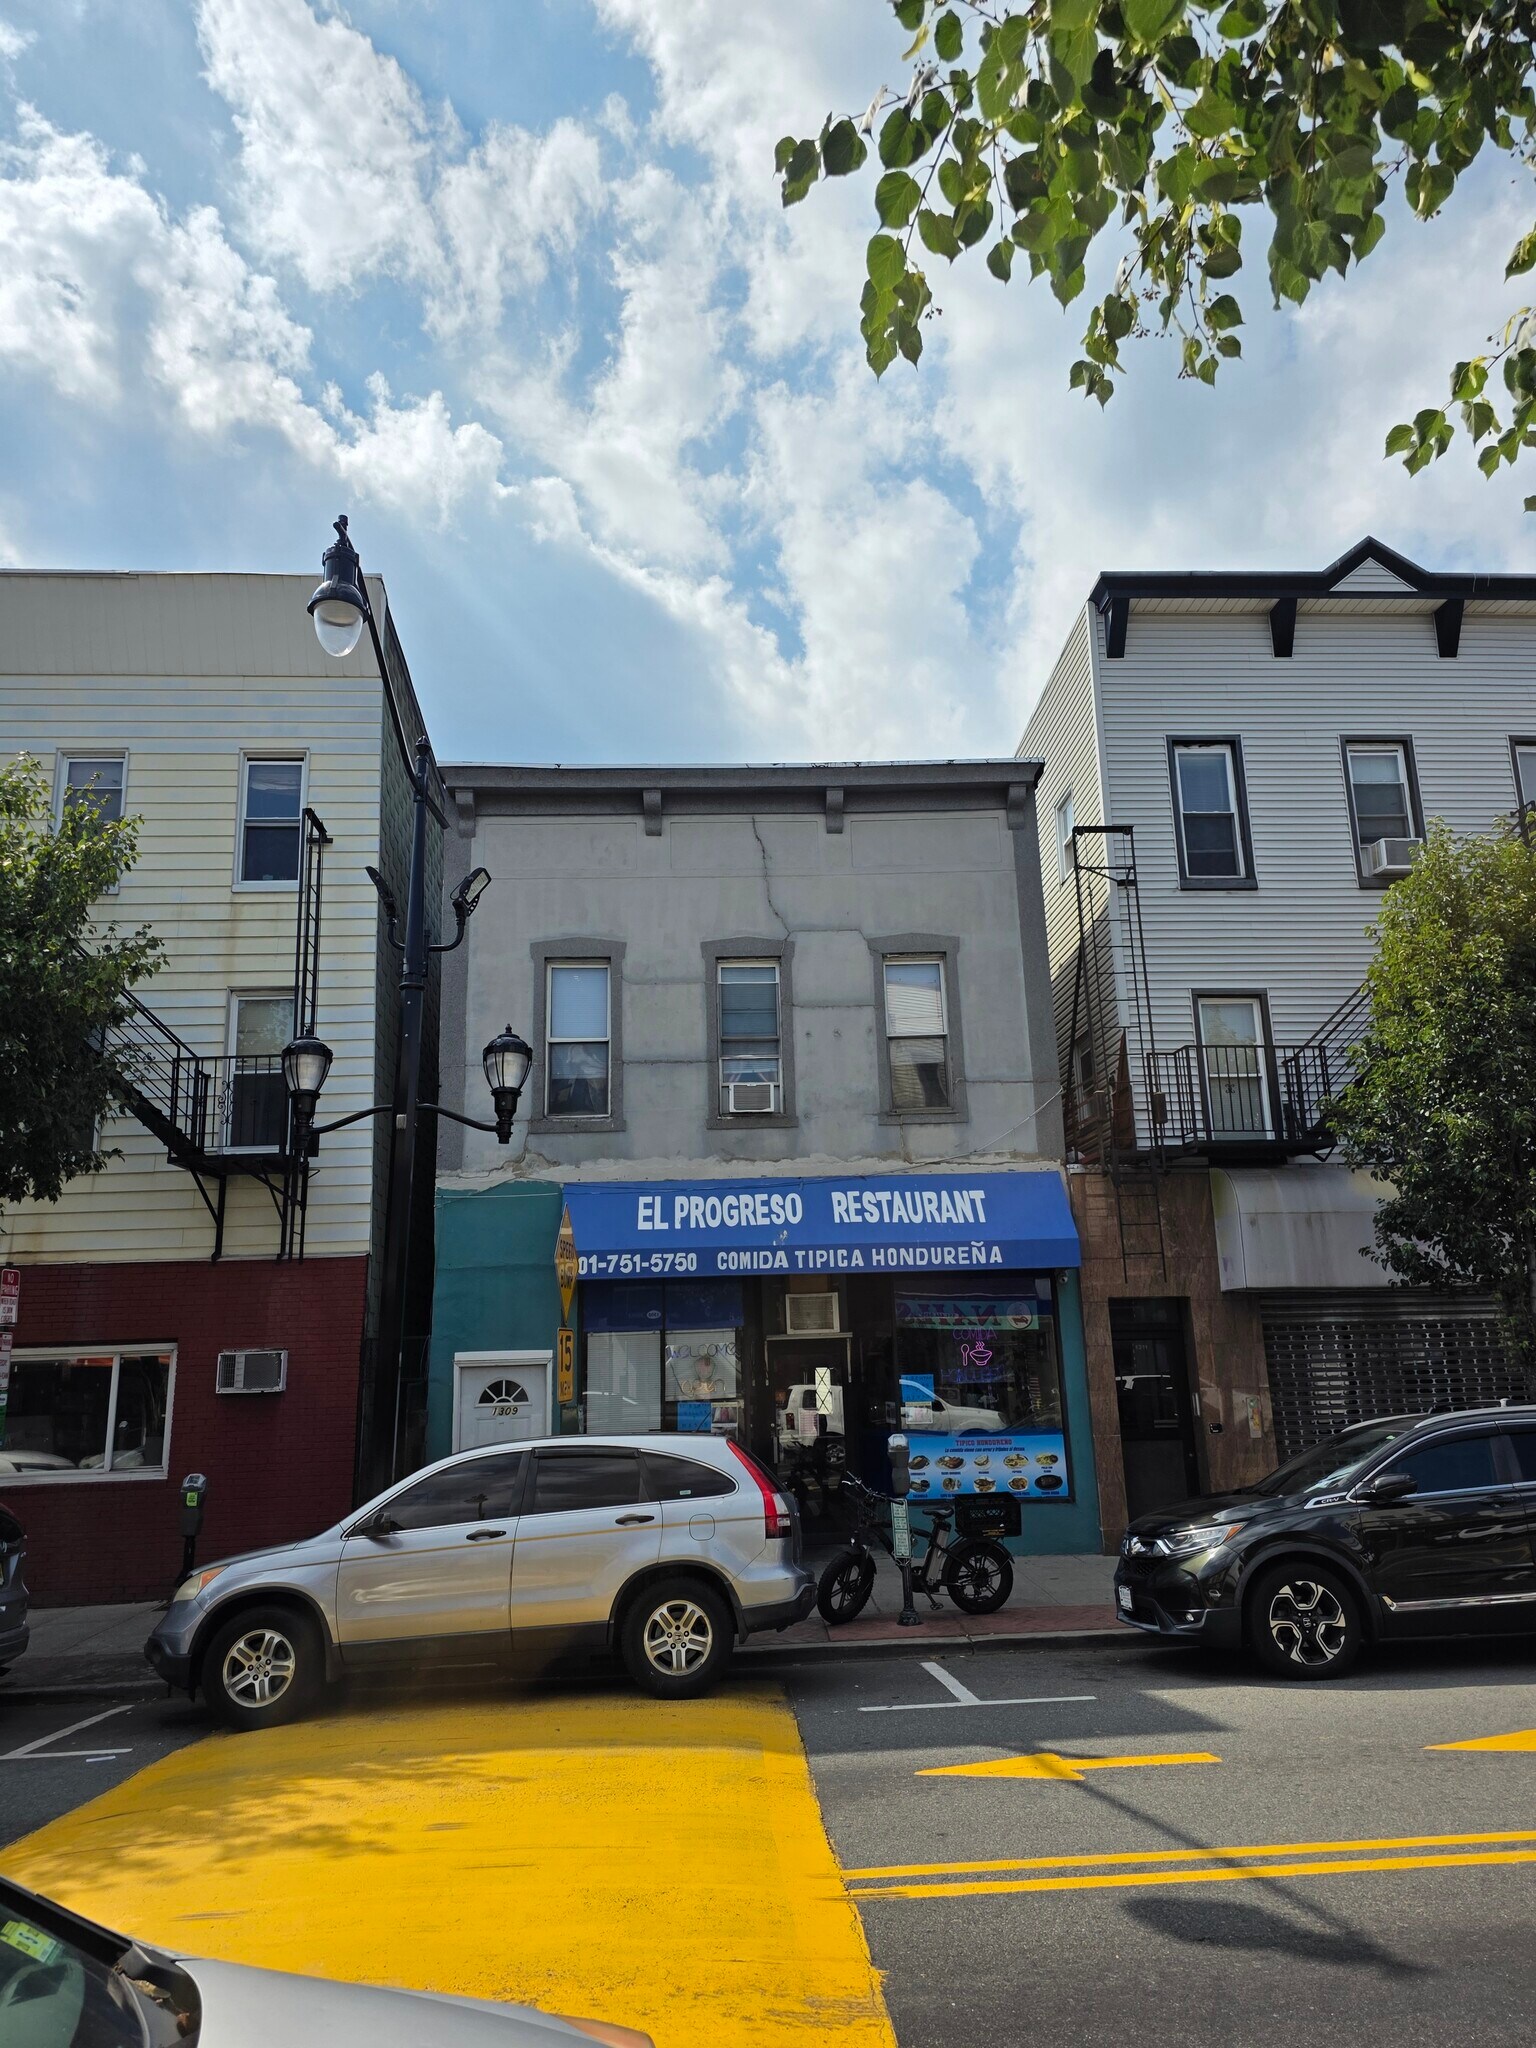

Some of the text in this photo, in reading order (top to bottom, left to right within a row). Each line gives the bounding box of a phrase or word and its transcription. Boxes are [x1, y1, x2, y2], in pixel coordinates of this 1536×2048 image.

[638, 1190, 986, 1230] EL PROGRESO RESTAURANT
[717, 1251, 789, 1270] COMIDA
[794, 1249, 865, 1268] TIPICA
[872, 1241, 1003, 1266] HONDUREÑA
[7, 1272, 15, 1284] NO
[560, 1334, 572, 1372] 15
[493, 1407, 518, 1416] 1309
